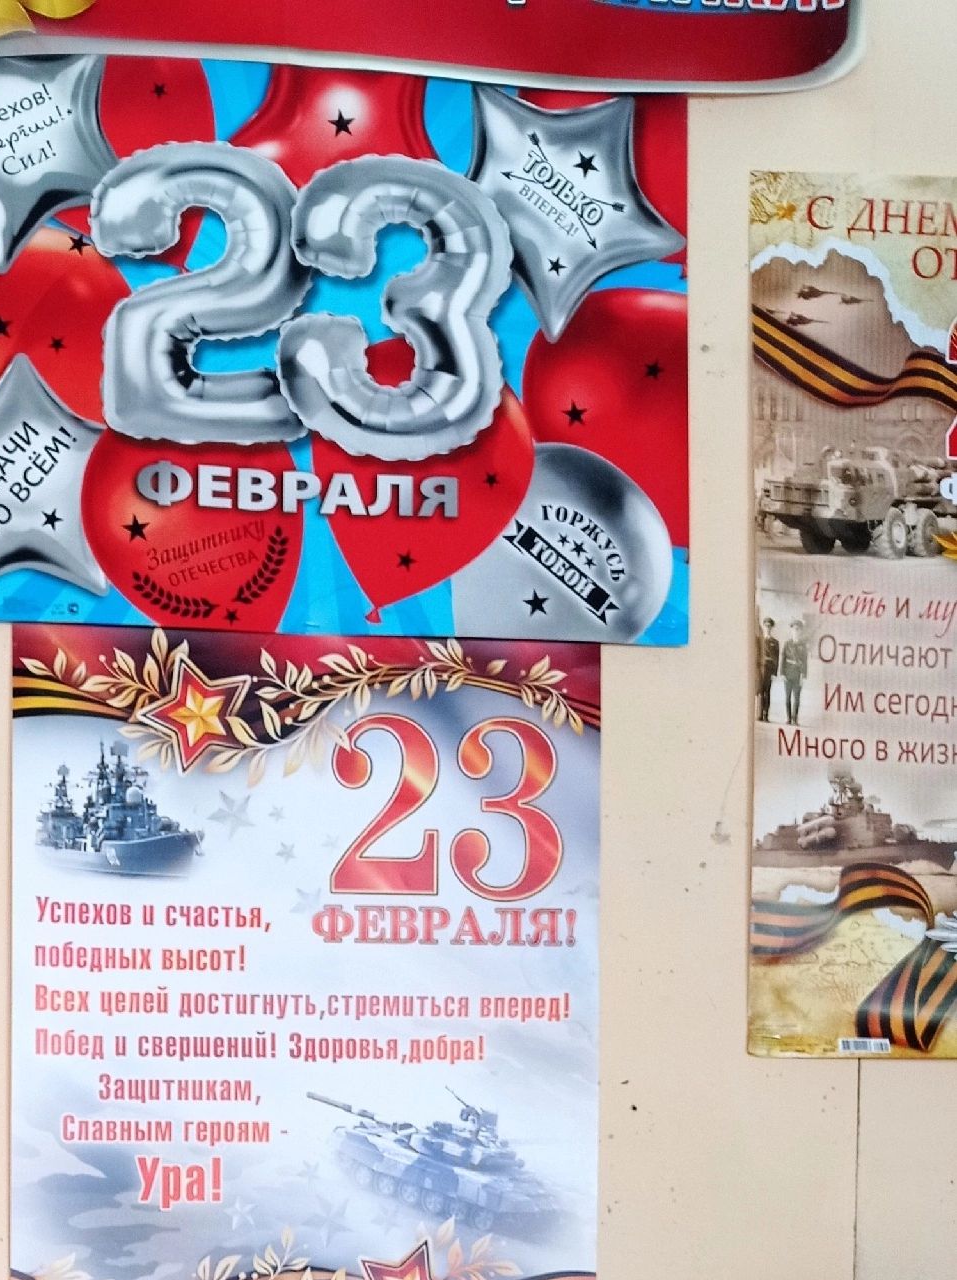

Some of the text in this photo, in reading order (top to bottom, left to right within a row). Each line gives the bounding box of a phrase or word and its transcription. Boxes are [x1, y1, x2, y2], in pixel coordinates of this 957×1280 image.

[2, 140, 57, 176] Сил!
[522, 150, 604, 226] ТОЛЬКО
[806, 195, 835, 230] С
[89, 140, 513, 461] 23
[9, 426, 78, 502] ВСЁМ!
[136, 460, 459, 518] ФЕВРАЛЯ
[147, 519, 265, 572] Защитнику
[541, 504, 626, 582] ГОРЖУСЬ
[167, 549, 259, 587] ОТЕЧЕСТВА
[530, 536, 596, 598] ТОБОЙ
[806, 581, 886, 618] Честь
[818, 634, 953, 670] Отличают
[824, 683, 865, 713] Им
[778, 728, 865, 761] Много
[876, 740, 888, 761] в
[330, 713, 564, 902] 23
[35, 895, 272, 932] Успехов и счастья,
[311, 903, 577, 948] ФЕВРАЛЯ!
[34, 941, 246, 973] победных высот!
[34, 984, 90, 1013] Всех
[100, 986, 169, 1018] целей
[480, 992, 571, 1022] вперед!
[34, 1028, 104, 1060] Побед
[114, 1034, 127, 1056] и
[138, 1032, 278, 1064] свершений!
[98, 1073, 262, 1106] Защитникам,
[61, 1114, 173, 1143] Славным
[184, 1118, 270, 1146] героям
[135, 1156, 224, 1212] Ура!
